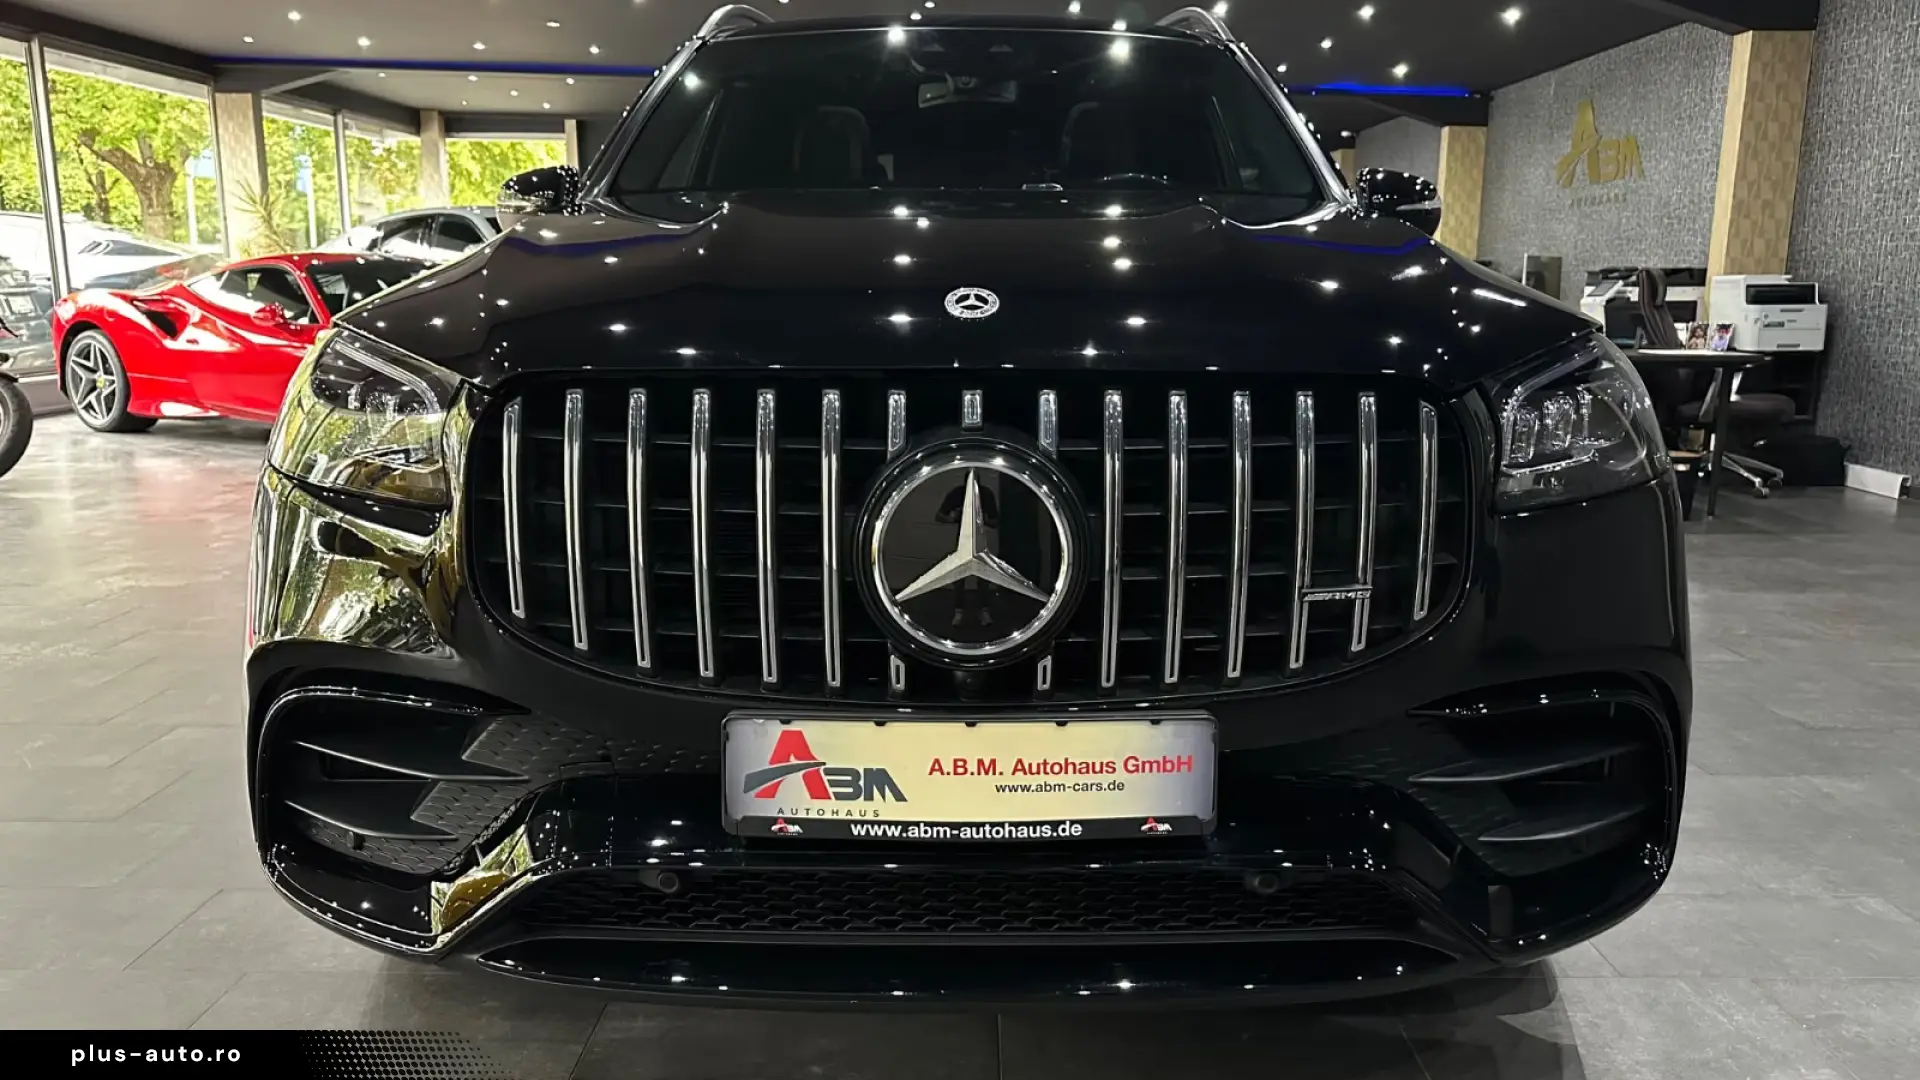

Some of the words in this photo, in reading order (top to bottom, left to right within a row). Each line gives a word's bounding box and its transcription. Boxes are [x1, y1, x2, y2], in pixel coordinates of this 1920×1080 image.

[743, 729, 908, 803] ABM
[928, 758, 1004, 776] A.B.M.
[1011, 758, 1117, 776] Autohaus
[1122, 755, 1193, 774] GmbH
[995, 779, 1125, 793] www.abm-cars.de
[777, 807, 880, 817] AUTOHAUS
[850, 820, 1083, 839] www.abm-autohaus.de
